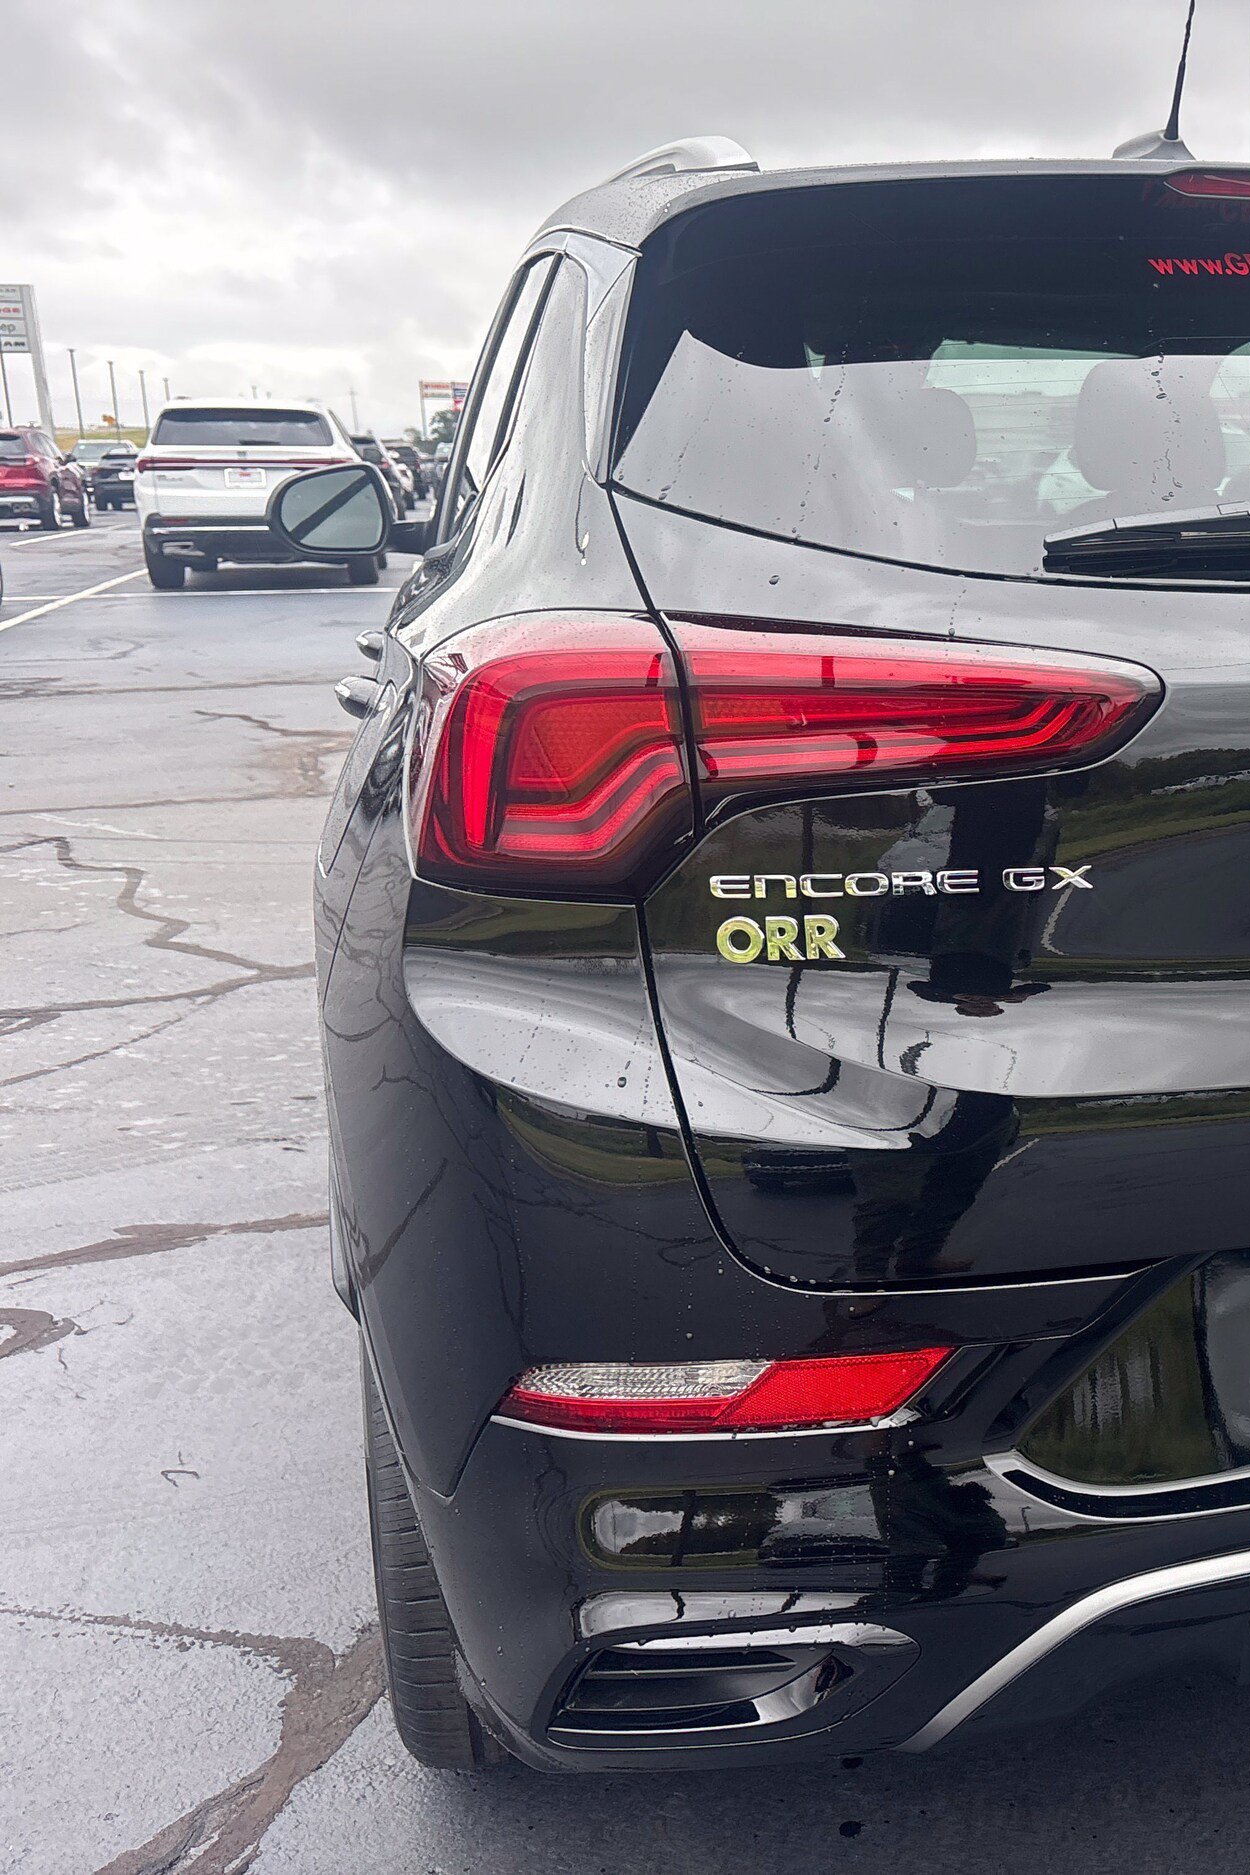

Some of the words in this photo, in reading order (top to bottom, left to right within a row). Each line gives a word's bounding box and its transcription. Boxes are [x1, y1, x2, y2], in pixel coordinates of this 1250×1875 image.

[709, 869, 980, 899] ENCORE
[1002, 864, 1094, 892] GX
[716, 914, 846, 964] ORR
